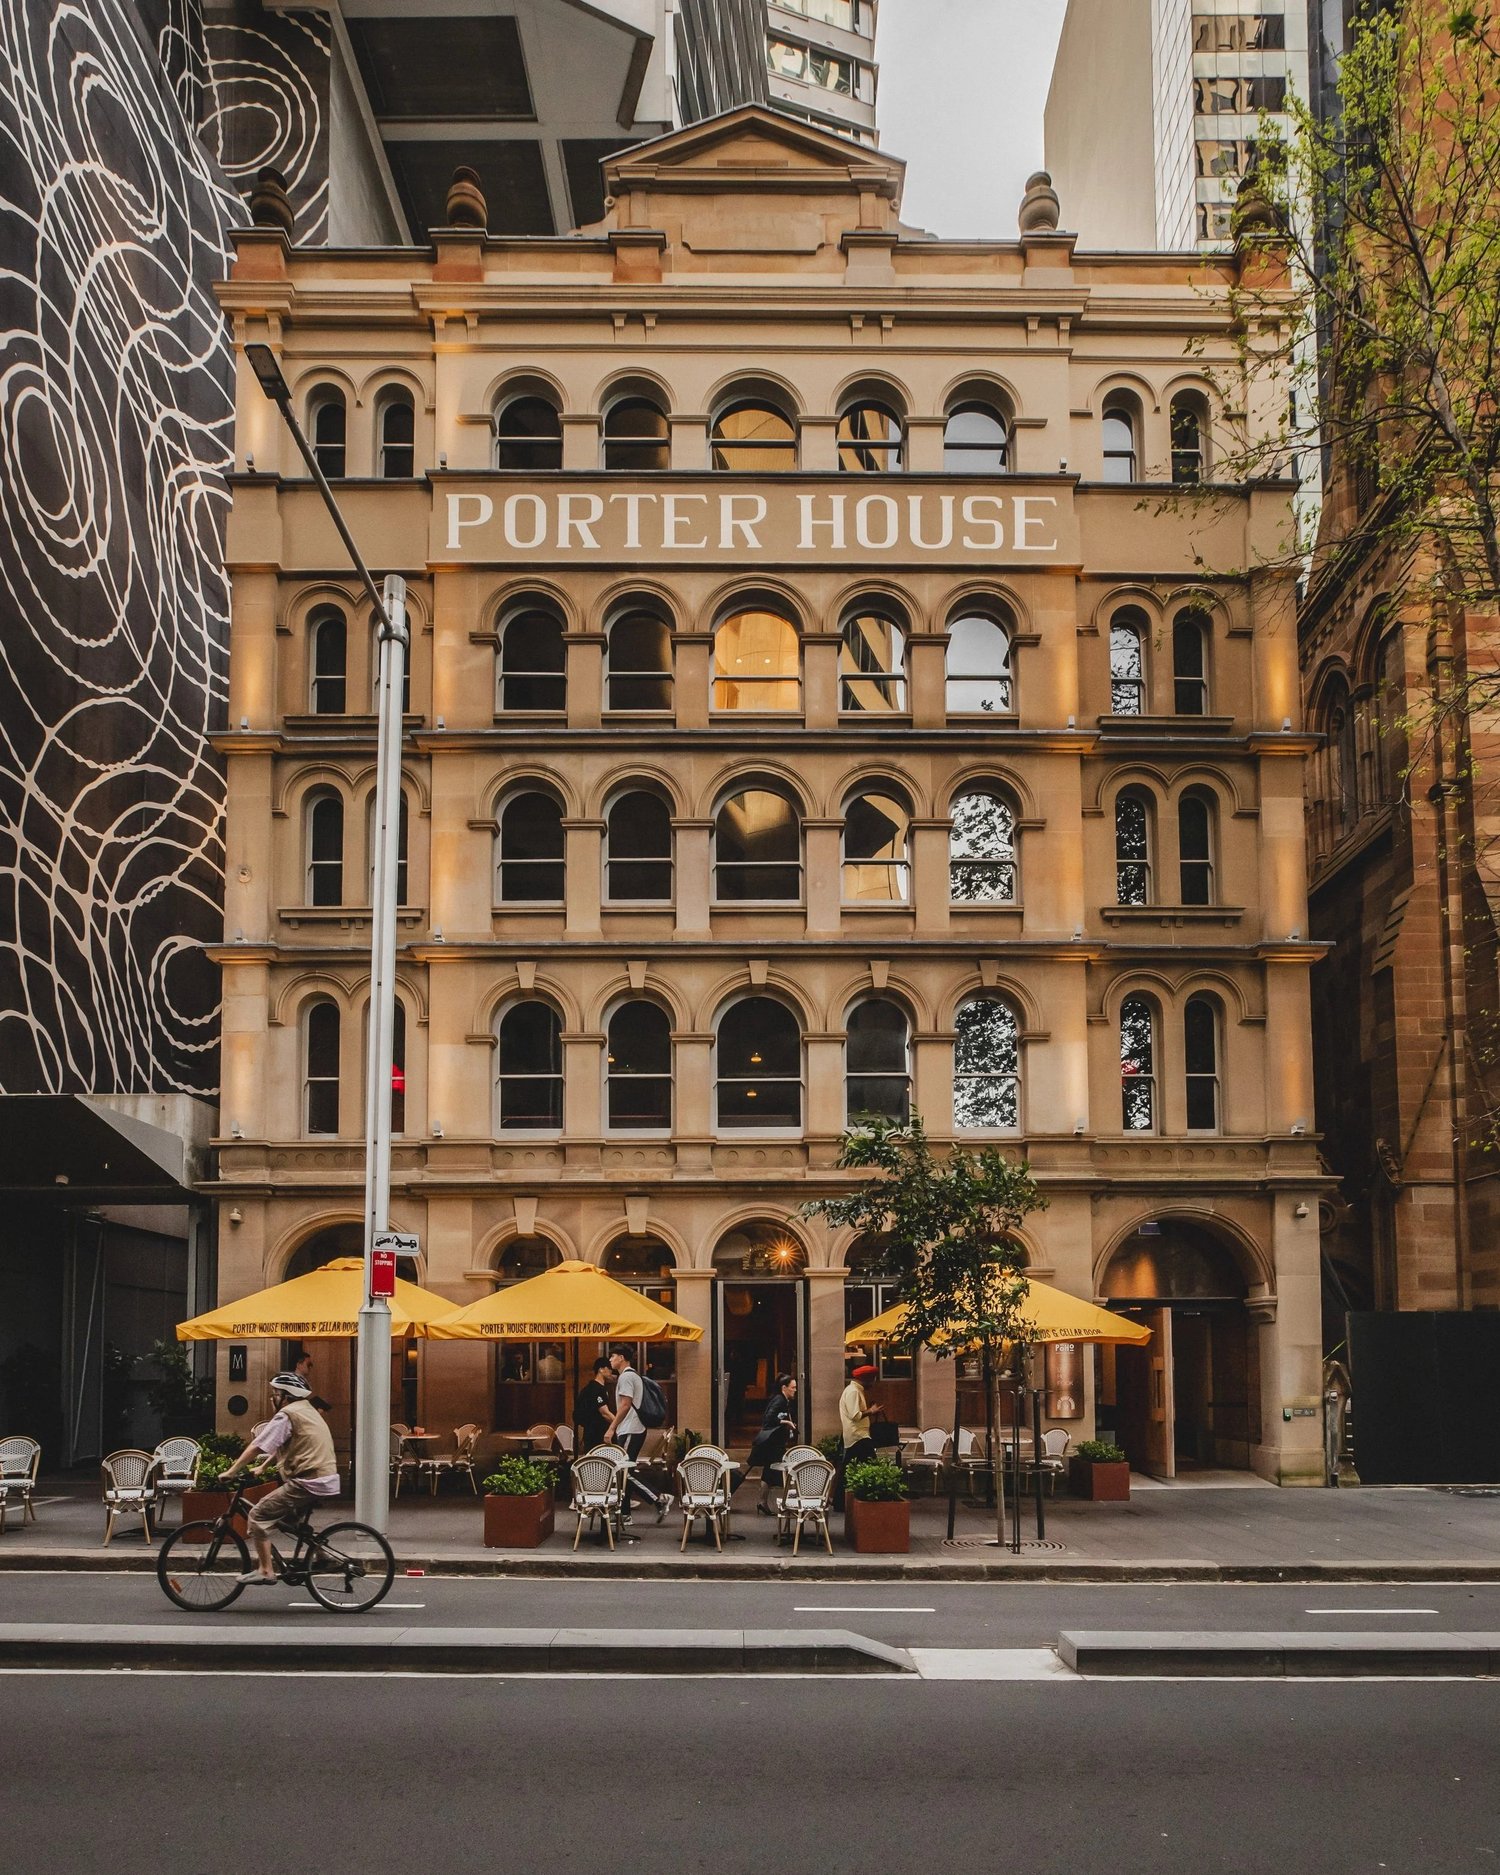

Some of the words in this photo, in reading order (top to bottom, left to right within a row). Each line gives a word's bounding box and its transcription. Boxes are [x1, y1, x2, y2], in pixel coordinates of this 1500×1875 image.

[445, 493, 767, 550] PORTER
[796, 494, 1058, 551] HOUSE
[232, 1324, 256, 1334] PORTER
[259, 1323, 279, 1333] HOUSE
[281, 1322, 310, 1333] GROUNDS
[312, 1323, 316, 1331] &
[319, 1322, 340, 1332] CELLAR
[480, 1323, 505, 1334] PORTER
[506, 1323, 527, 1334] HOUSE
[529, 1323, 559, 1334] GROUNDS
[561, 1323, 566, 1333] &
[568, 1323, 591, 1334] CELLAR
[593, 1323, 611, 1334] DOOR
[1052, 1329, 1059, 1338] &
[1060, 1328, 1083, 1337] CELLAR
